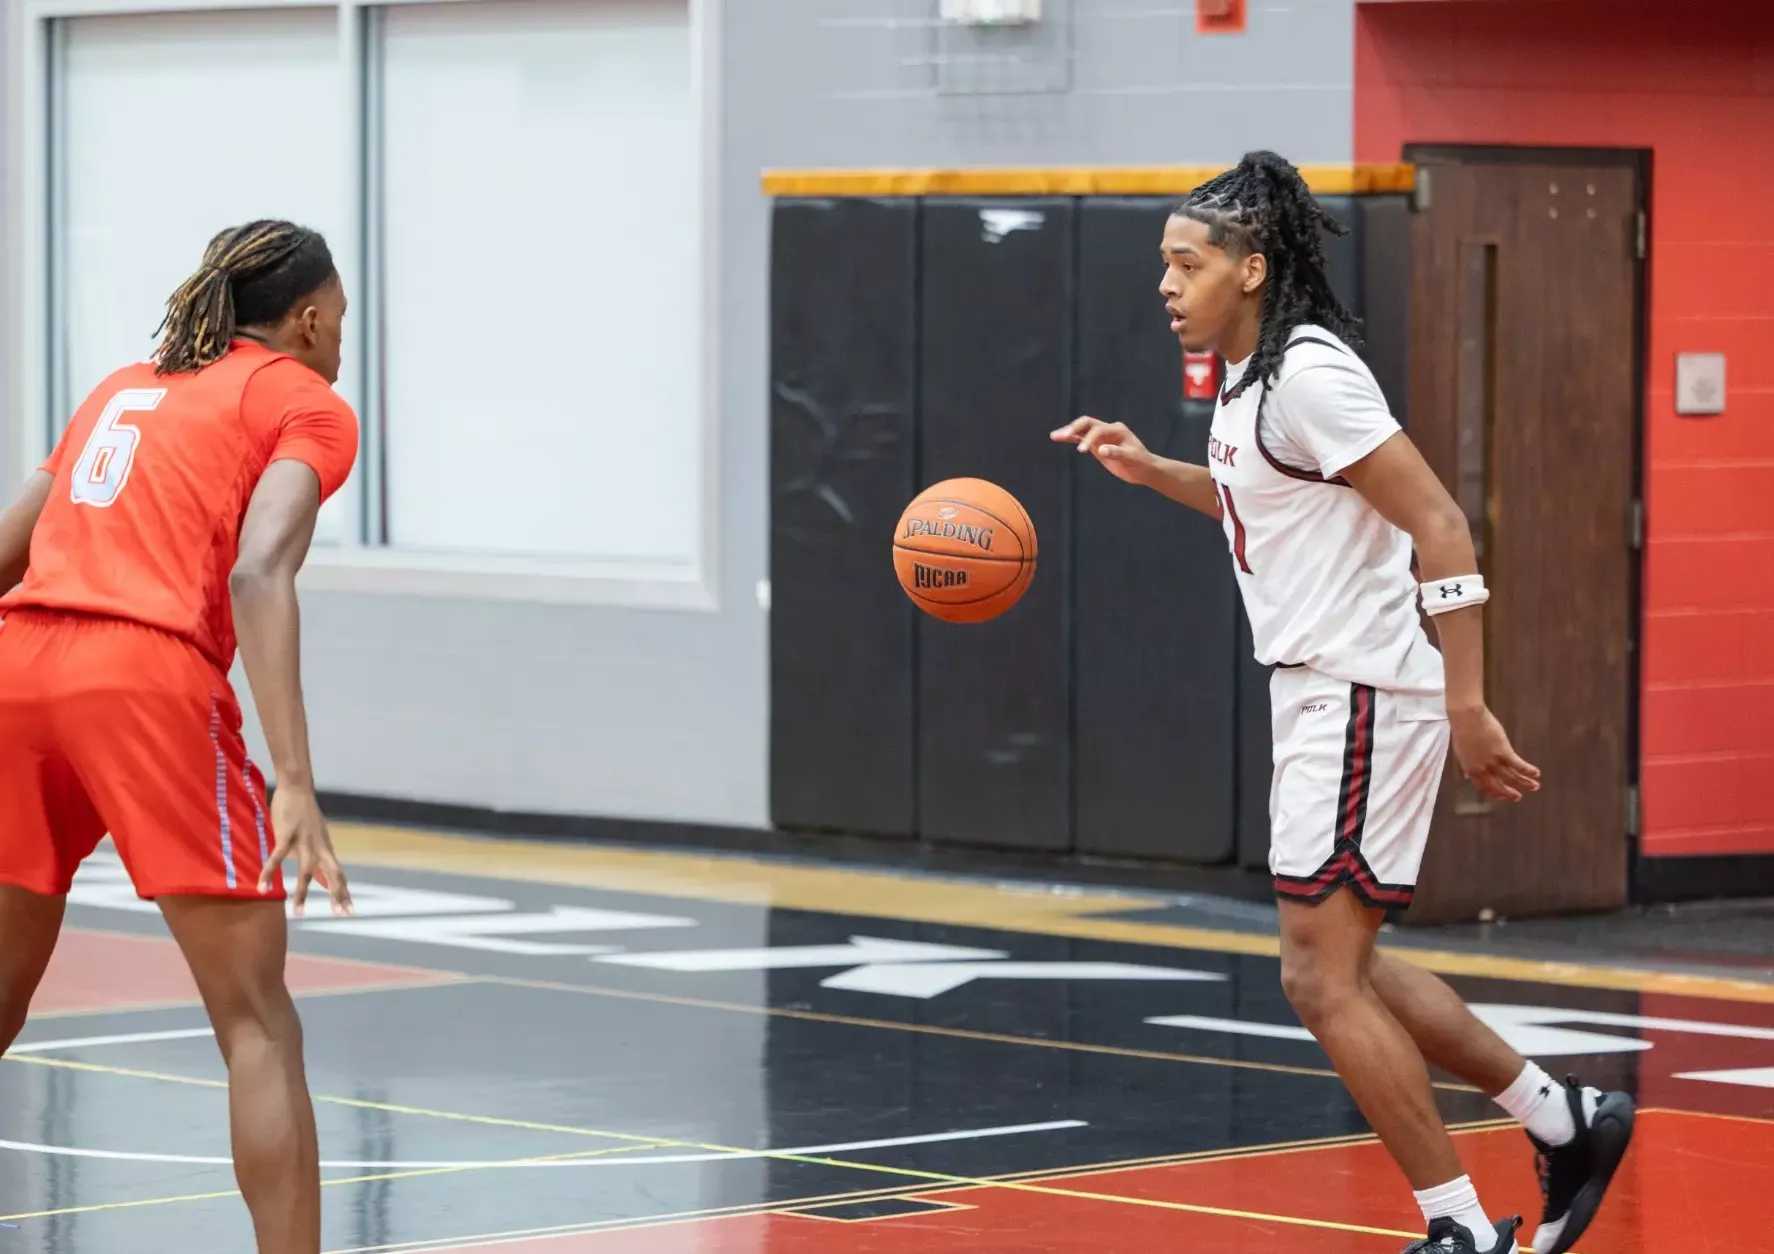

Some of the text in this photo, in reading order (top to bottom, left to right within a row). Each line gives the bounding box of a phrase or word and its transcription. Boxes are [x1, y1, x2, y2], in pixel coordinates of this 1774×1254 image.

[71, 388, 168, 508] 6
[903, 518, 993, 551] SPALDING
[914, 563, 967, 588] NJCAA
[1301, 704, 1328, 714] POLK
